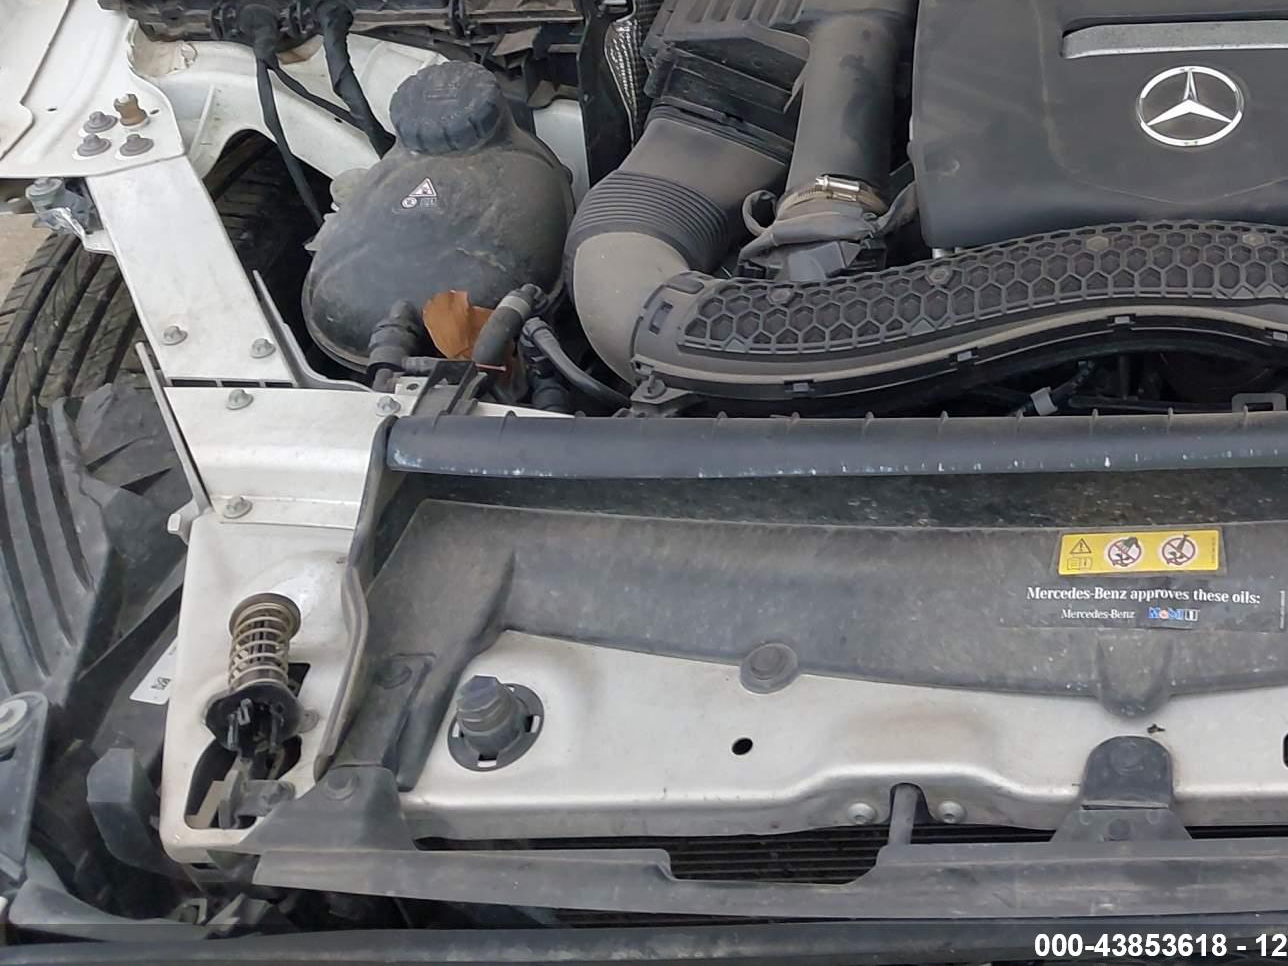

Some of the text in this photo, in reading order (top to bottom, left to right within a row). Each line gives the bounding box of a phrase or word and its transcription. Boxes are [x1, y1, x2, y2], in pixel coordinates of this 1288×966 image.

[1027, 587, 1261, 605] Mercedes-Benz approves these oils:
[1061, 609, 1136, 619] Mercedes-Benz
[1147, 606, 1185, 620] Mobil
